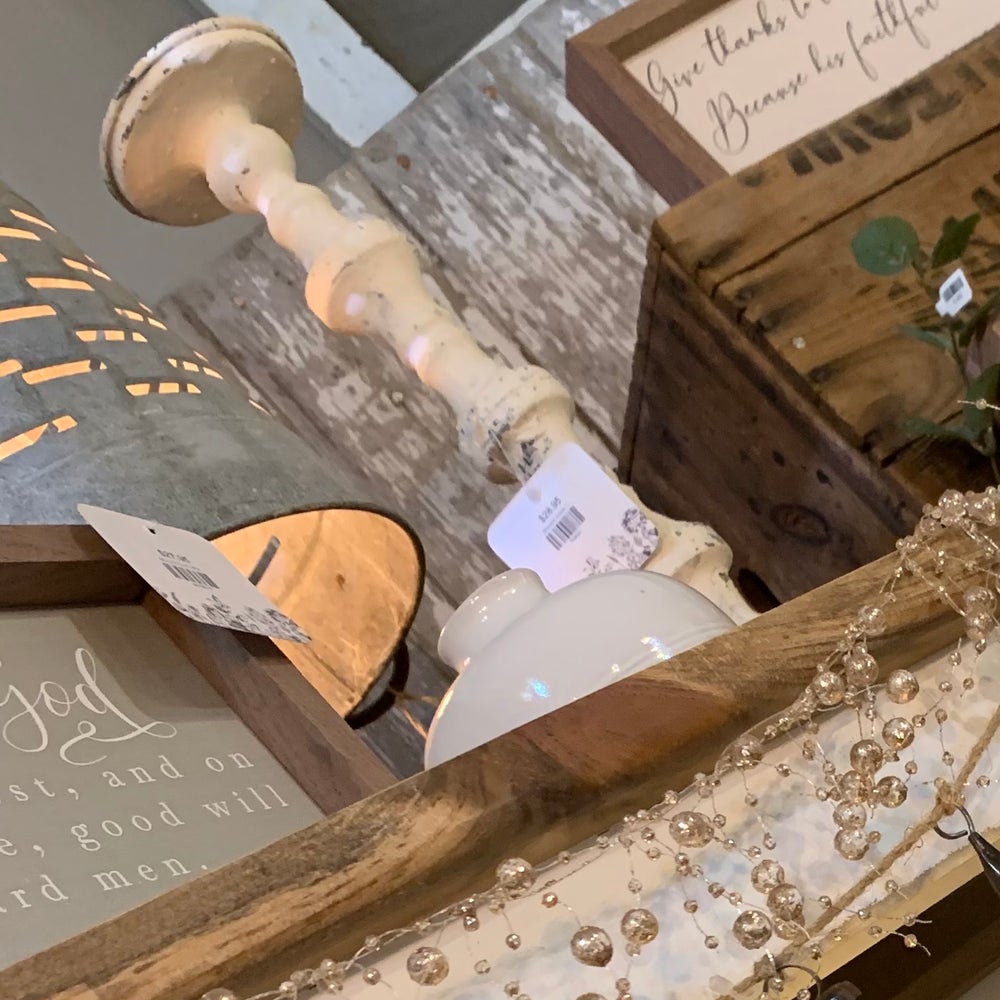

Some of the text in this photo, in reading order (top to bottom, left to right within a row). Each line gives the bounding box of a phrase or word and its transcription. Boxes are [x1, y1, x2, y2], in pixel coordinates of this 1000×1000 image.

[646, 59, 705, 117] Give
[700, 0, 789, 67] thanks
[706, 70, 808, 156] Because
[808, 42, 846, 75] his
[0, 751, 255, 802] st, and on
[70, 802, 186, 852] good
[202, 784, 290, 819] will
[0, 855, 209, 914] rd men.
